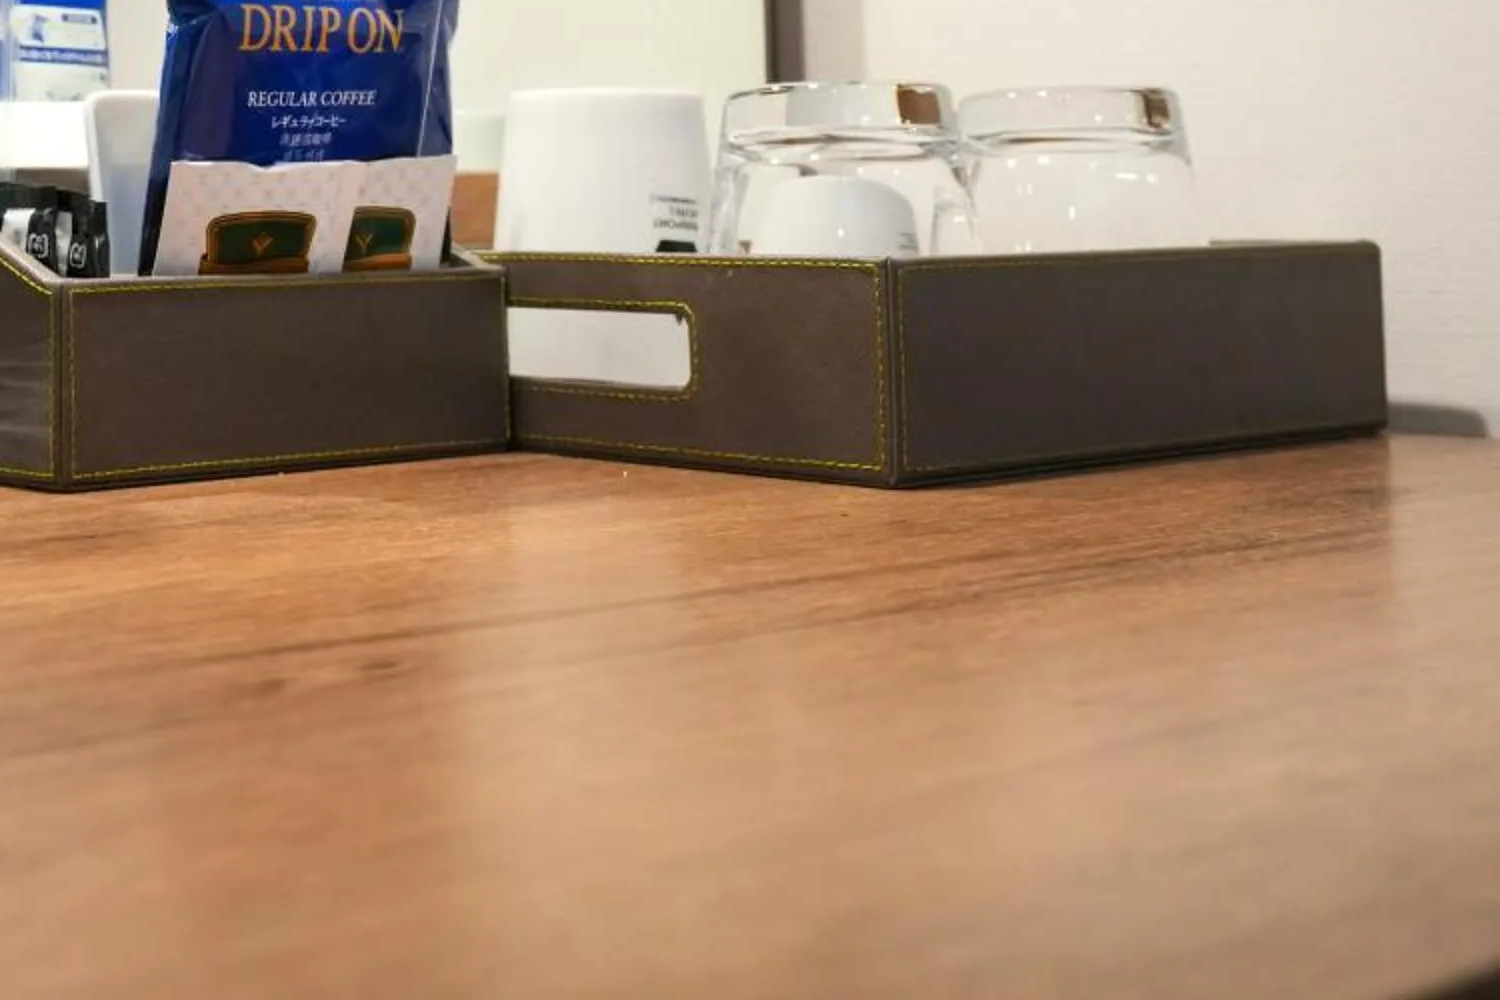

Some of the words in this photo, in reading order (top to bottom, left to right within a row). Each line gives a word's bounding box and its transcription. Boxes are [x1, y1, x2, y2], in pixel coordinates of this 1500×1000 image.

[239, 3, 342, 53] DRIP
[347, 7, 404, 54] ON
[247, 91, 318, 108] REGULAR
[320, 89, 377, 106] COFFEE
